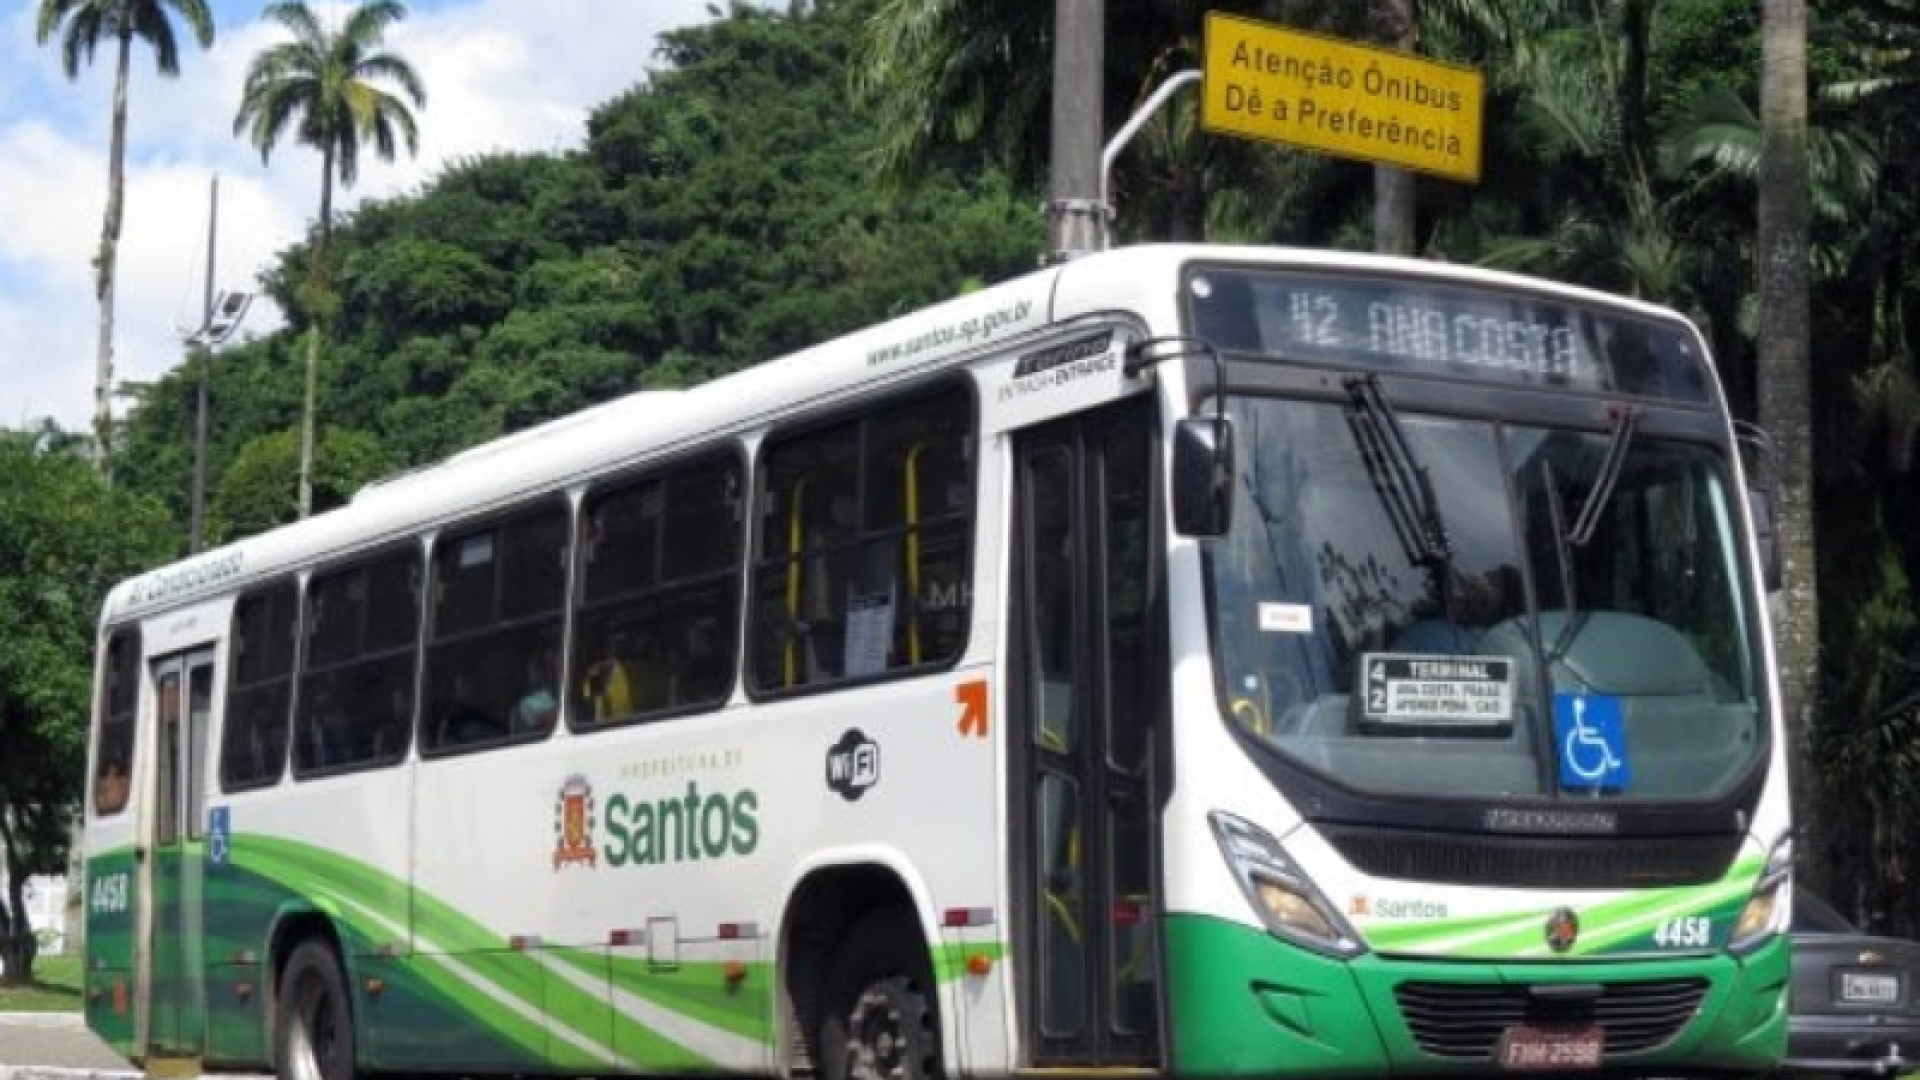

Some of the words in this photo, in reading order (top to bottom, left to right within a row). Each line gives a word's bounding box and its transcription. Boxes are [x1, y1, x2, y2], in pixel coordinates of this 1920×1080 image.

[1230, 40, 1354, 89] Atenção
[1364, 60, 1461, 112] Ônibus
[1226, 84, 1263, 116] Dê
[1273, 98, 1288, 121] a
[1298, 98, 1461, 157] Preferência
[1290, 291, 1340, 346] 42
[1368, 303, 1448, 362] ANA
[1453, 316, 1576, 377] COSTA
[1408, 660, 1490, 680] TERMINAL
[603, 780, 760, 867] Santos
[1374, 896, 1449, 918] Santos
[1654, 915, 1711, 947] 4458
